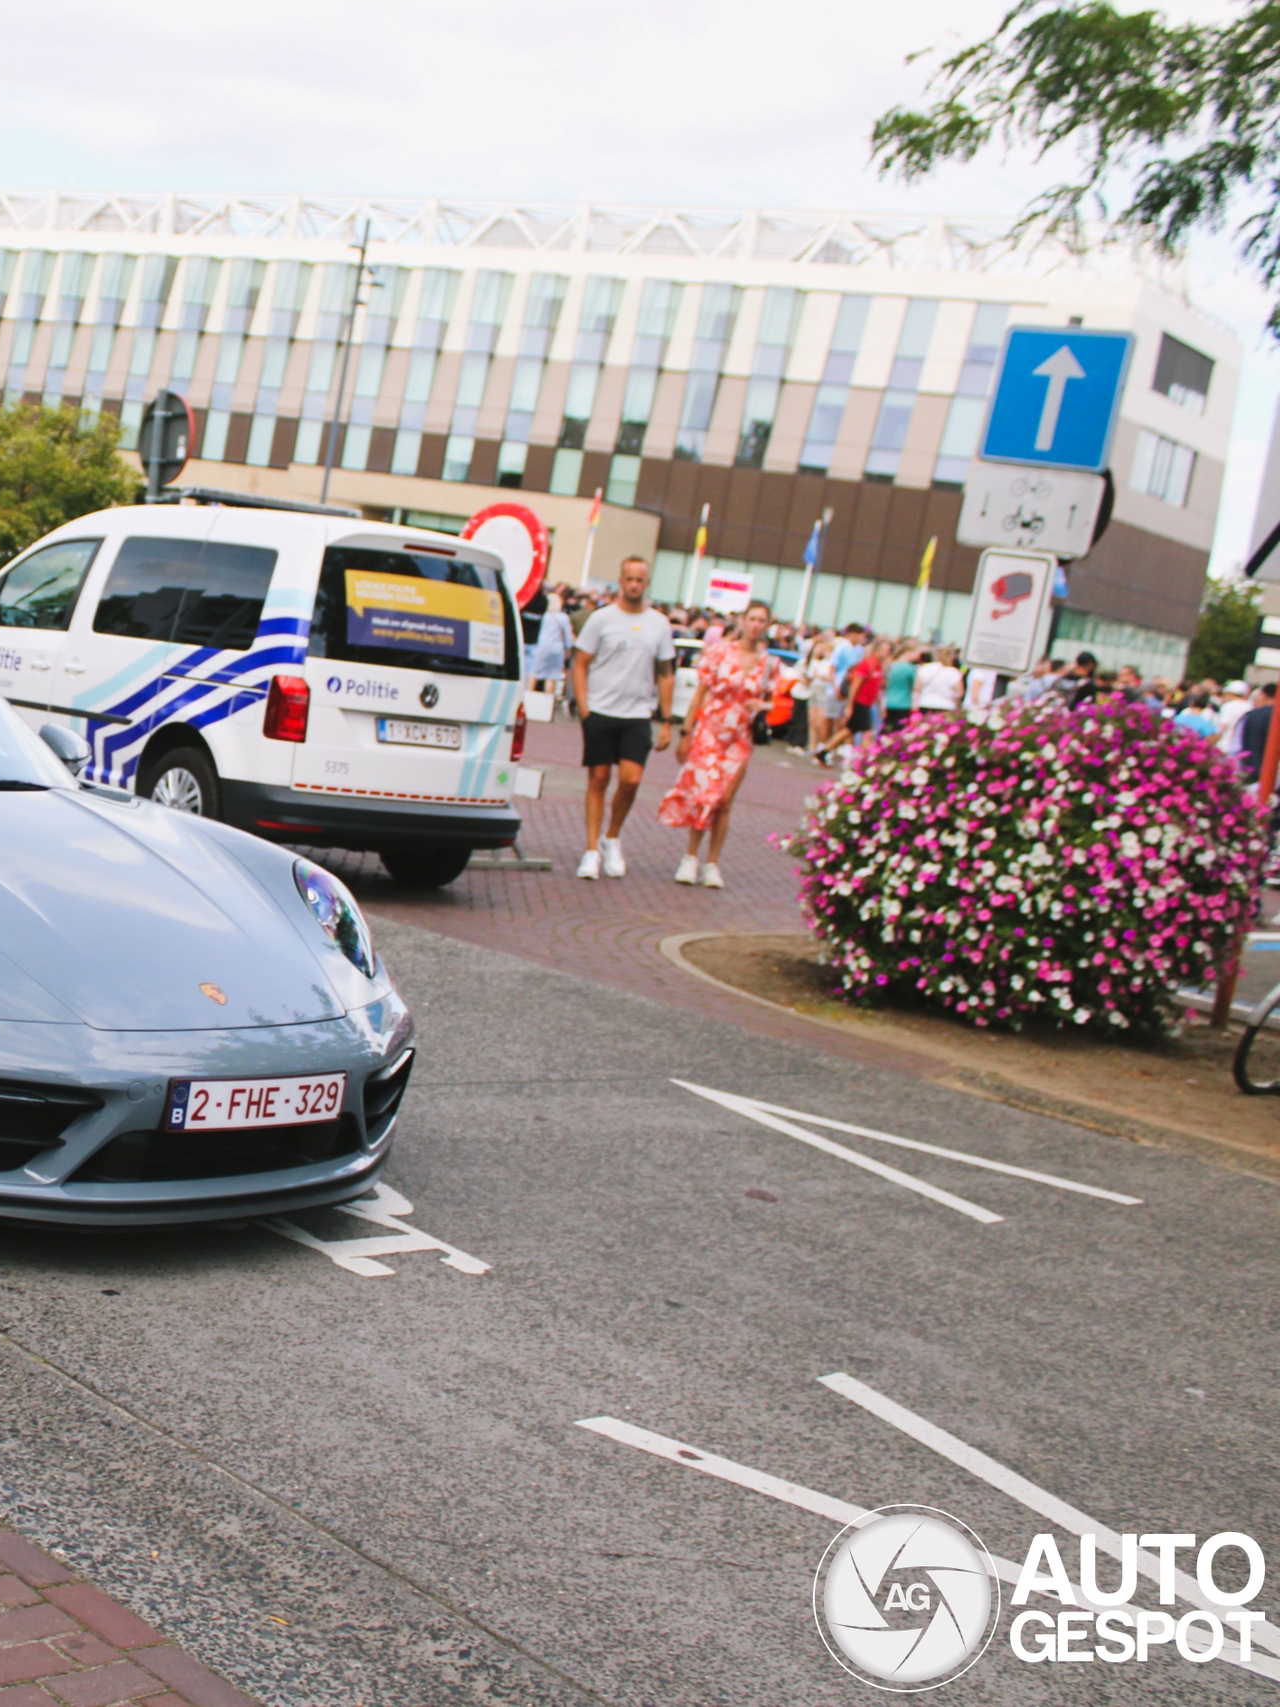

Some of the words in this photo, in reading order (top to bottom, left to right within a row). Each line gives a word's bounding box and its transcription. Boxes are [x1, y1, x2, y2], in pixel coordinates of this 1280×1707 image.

[355, 580, 386, 591] LOKALE
[387, 583, 417, 595] POLITIE
[346, 679, 399, 700] Politie
[324, 760, 350, 775] 5375
[171, 1108, 184, 1124] B
[190, 1081, 339, 1122] 2-FHE-329
